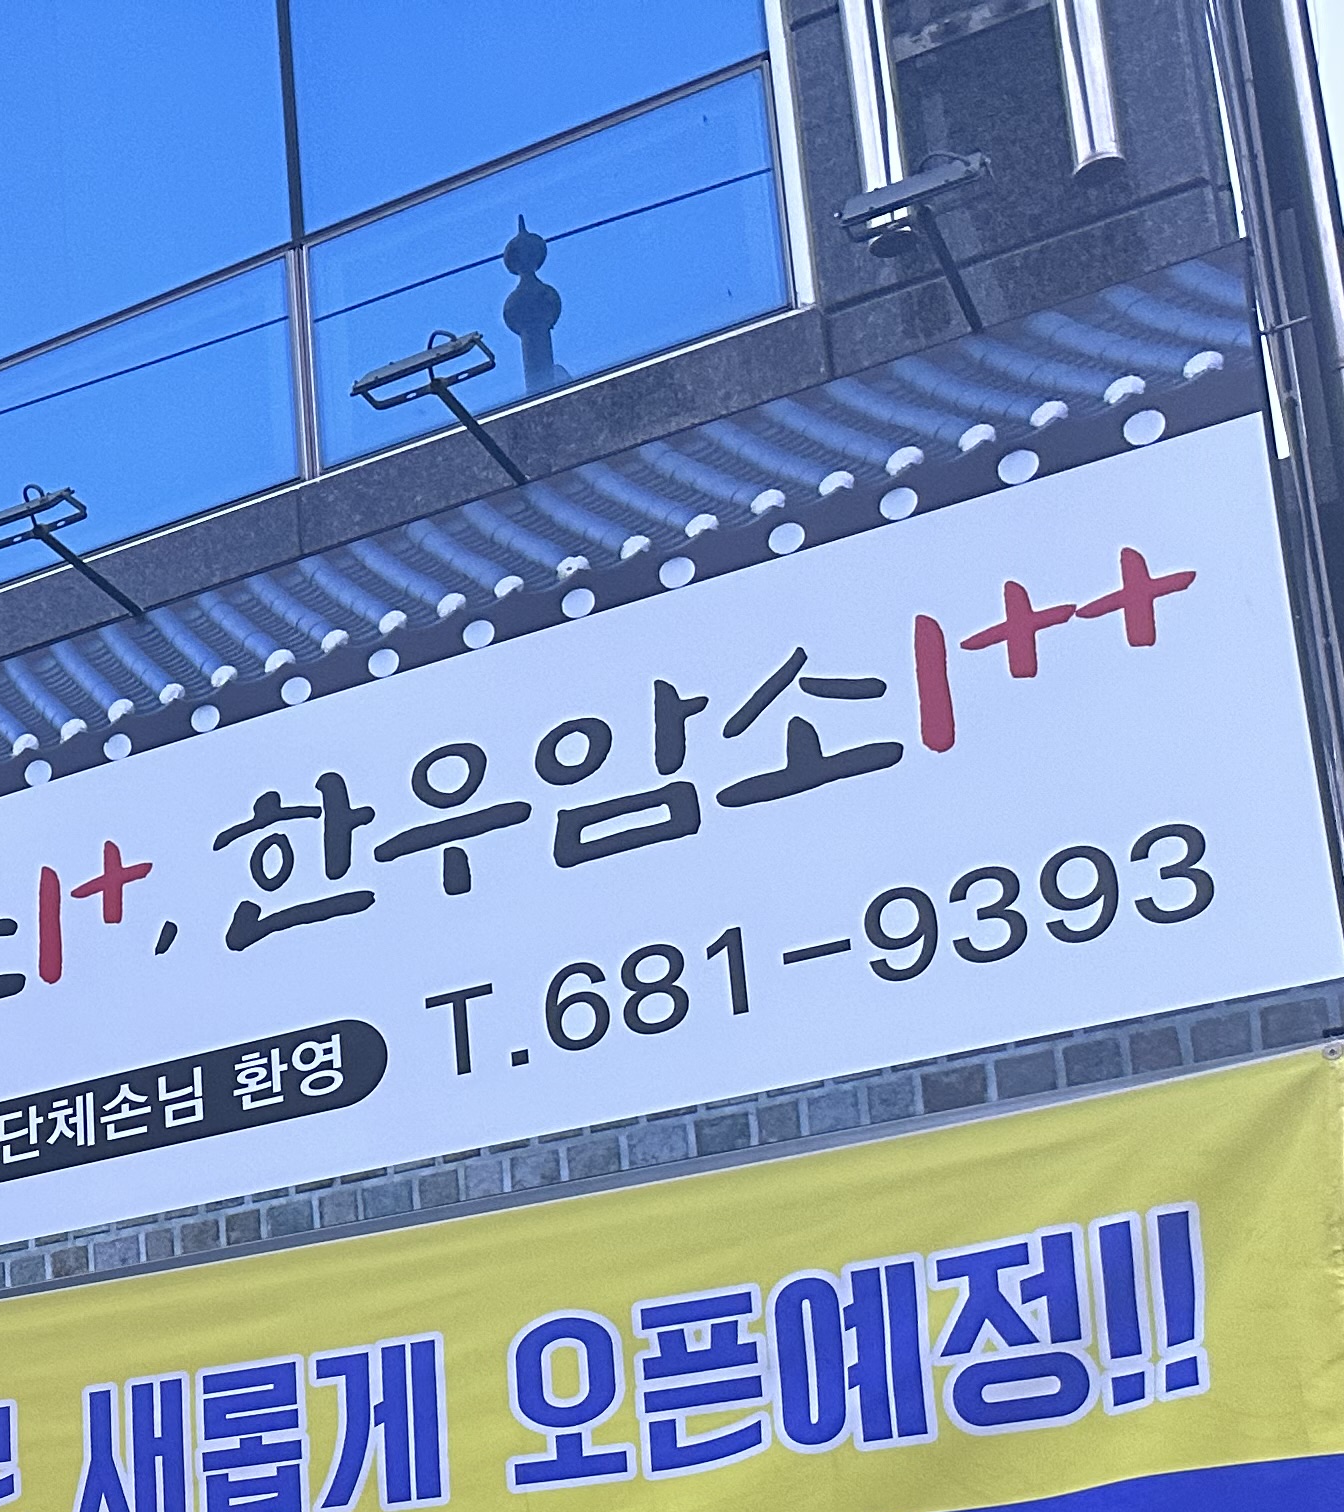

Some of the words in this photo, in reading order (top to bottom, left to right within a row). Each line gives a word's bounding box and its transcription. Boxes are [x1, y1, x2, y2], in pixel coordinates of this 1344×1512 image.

[231, 1030, 348, 1106] 환영
[424, 821, 1219, 1079] T.681-9393
[509, 1204, 1208, 1492] 오픈예정!!
